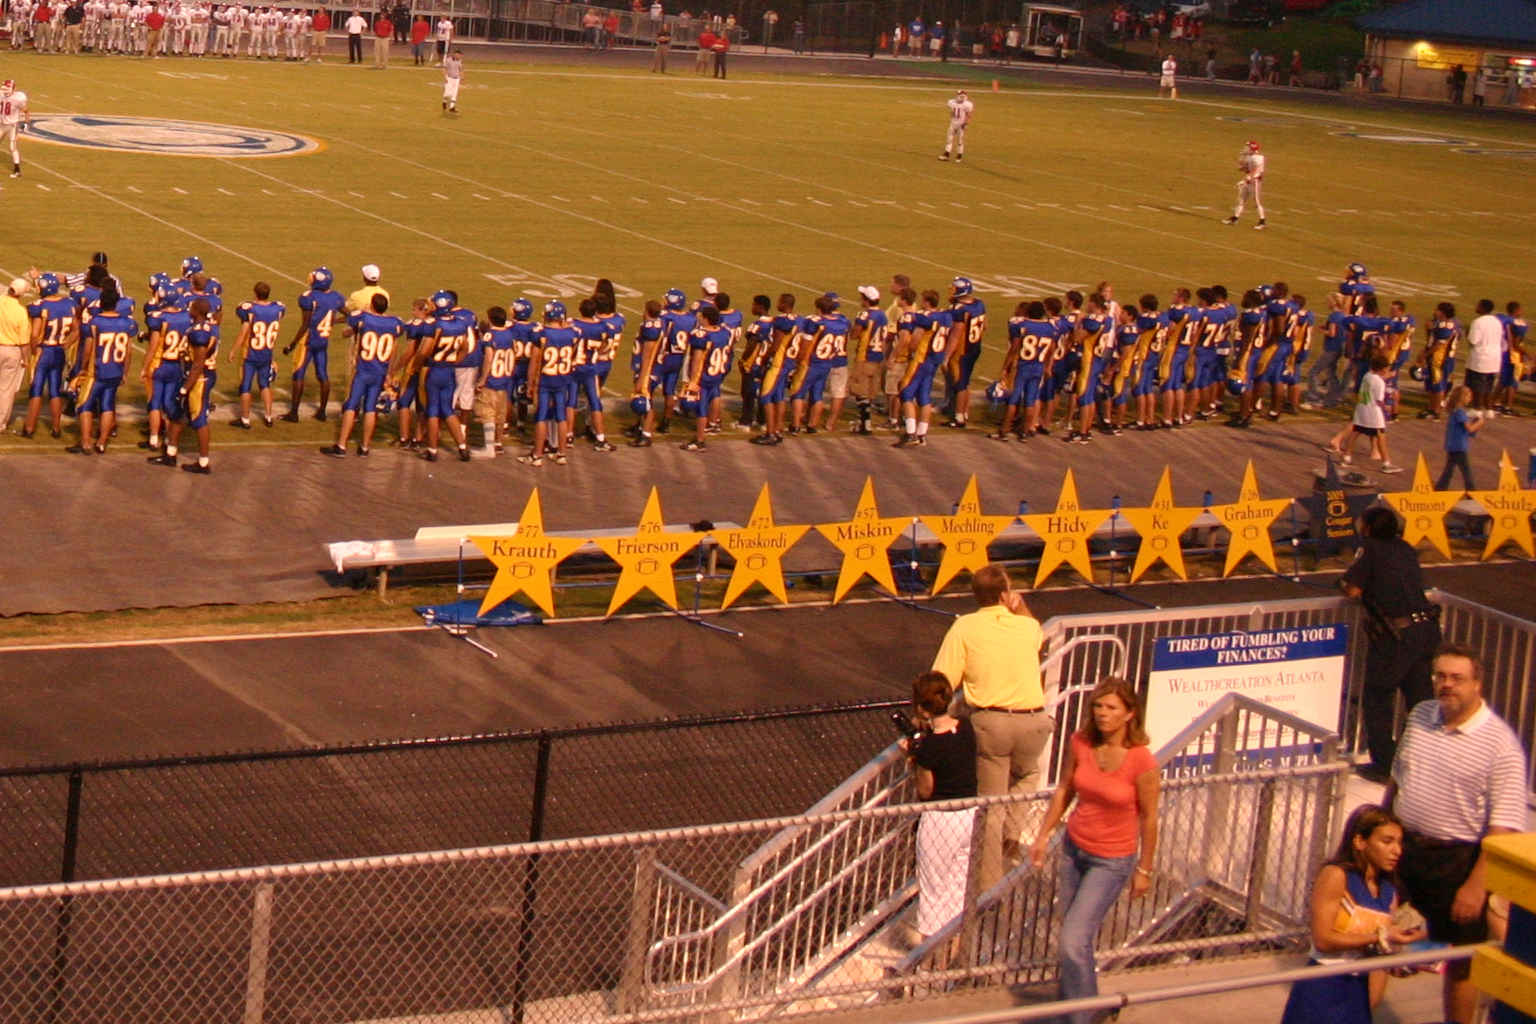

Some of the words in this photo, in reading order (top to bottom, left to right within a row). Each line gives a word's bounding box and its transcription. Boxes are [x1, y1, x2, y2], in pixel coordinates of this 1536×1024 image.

[250, 320, 280, 351] 36
[98, 332, 129, 364] 78
[360, 330, 394, 363] 90
[1019, 334, 1052, 363] 87
[490, 348, 514, 379] 60
[541, 345, 573, 376] 23
[1224, 504, 1274, 521] Graham
[1399, 498, 1446, 513] Dumont
[1484, 495, 1532, 512] Schulz
[856, 507, 876, 520] #57
[518, 525, 540, 538] #77
[639, 521, 660, 534] #76
[836, 524, 893, 541] Miskin
[942, 517, 994, 535] Mechling
[1047, 516, 1089, 534] Hidy
[492, 539, 557, 559] Krauth
[617, 538, 679, 555] Frierson
[1167, 637, 1209, 653] TIRED
[1211, 636, 1230, 650] OF
[1231, 630, 1298, 648] FUMBLING
[1301, 627, 1335, 643] YOUR
[1216, 646, 1288, 664] FINANCES?
